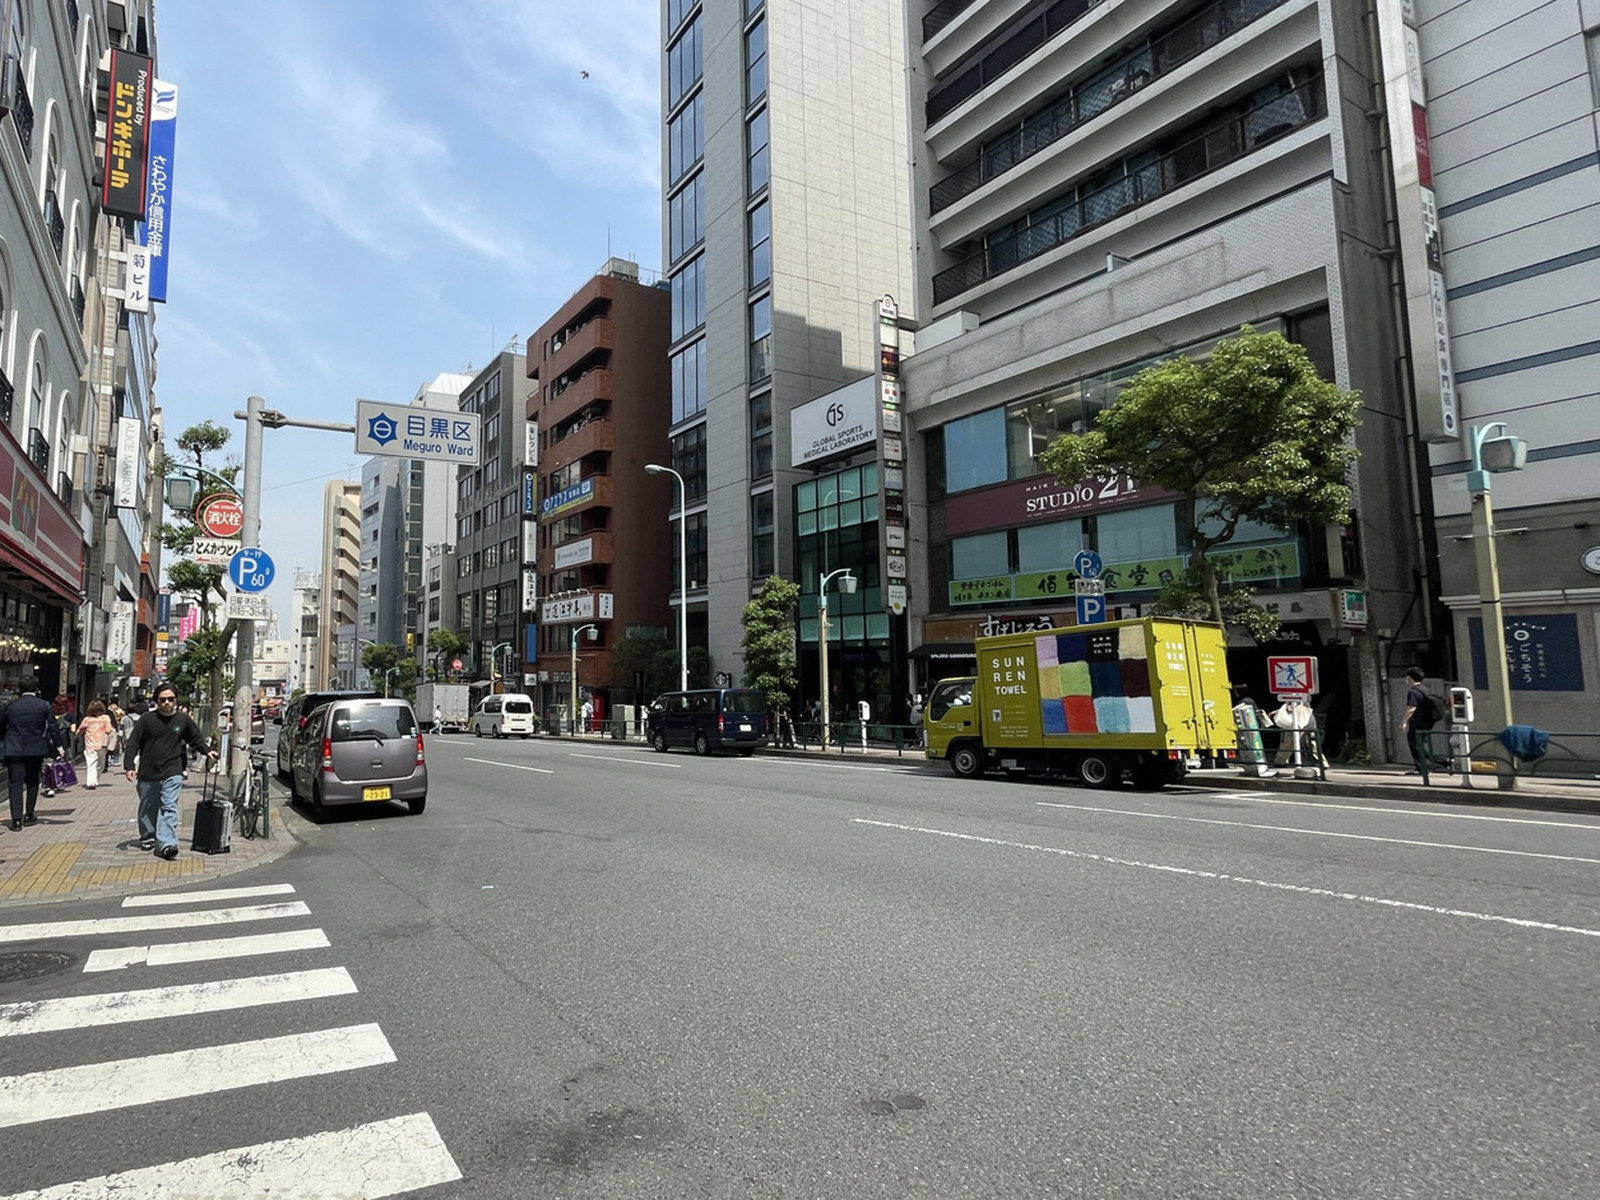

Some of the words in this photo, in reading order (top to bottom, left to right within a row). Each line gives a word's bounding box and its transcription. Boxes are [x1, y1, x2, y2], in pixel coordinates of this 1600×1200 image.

[137, 69, 148, 114] Produced
[134, 112, 144, 126] by
[147, 154, 167, 258] さわやか信用金庫
[130, 254, 146, 302] 菊ビル
[124, 420, 135, 452] ALICE
[408, 414, 472, 442] 目黒区
[812, 435, 836, 448] GLOBAL
[838, 424, 864, 438] SPORTS
[404, 438, 442, 454] Meguro
[447, 443, 474, 456] Ward
[804, 445, 829, 458] MEDICAL
[830, 429, 874, 450] LABORATORY
[121, 454, 133, 496] MARION
[1026, 484, 1048, 492] HAIR
[1026, 483, 1094, 512] STUDIO
[208, 511, 240, 526] 消火栓
[244, 550, 262, 558] 9-19
[239, 557, 258, 586] P
[251, 573, 264, 587] 60
[1080, 558, 1092, 576] P
[1083, 598, 1100, 622] P
[992, 656, 1024, 668] SUN
[1520, 642, 1533, 684] ごちそう
[993, 671, 1026, 682] REN
[994, 685, 1027, 695] TOWEL
